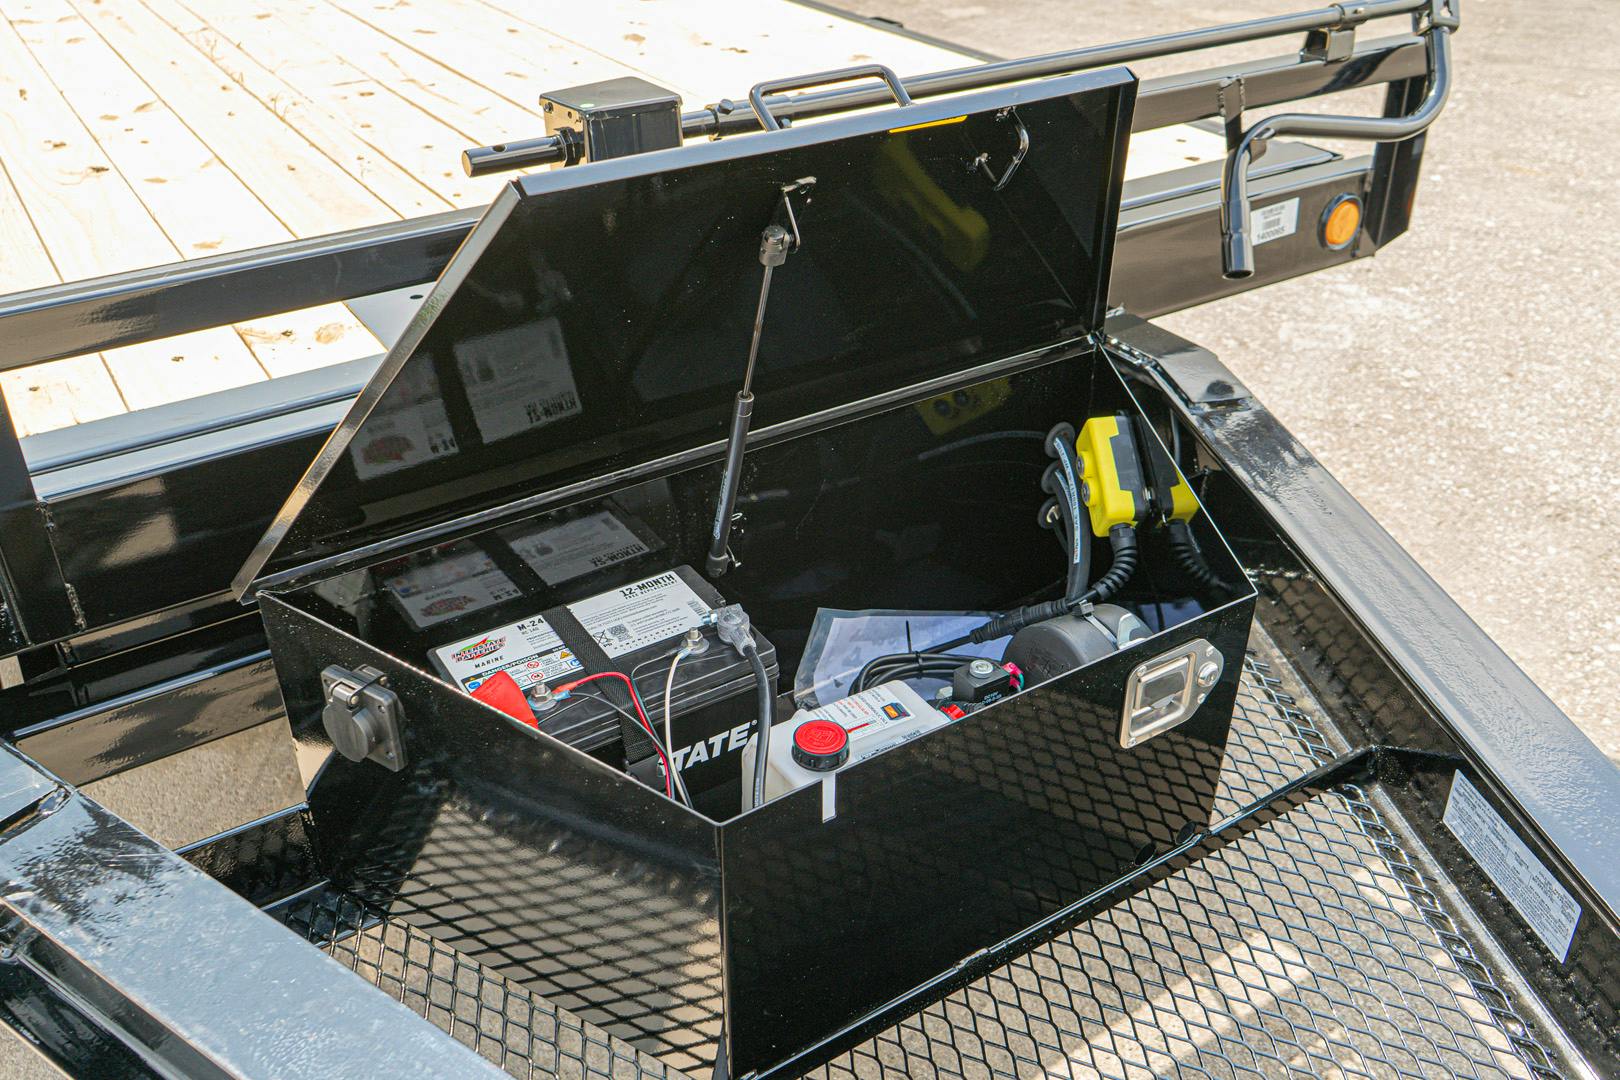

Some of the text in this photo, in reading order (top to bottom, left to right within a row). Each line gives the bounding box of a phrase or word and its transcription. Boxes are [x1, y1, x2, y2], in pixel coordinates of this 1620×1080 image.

[619, 574, 675, 597] 12-MONTH
[640, 580, 678, 595] REPLACEMENT
[517, 617, 545, 632] M-24
[451, 637, 507, 659] INTERSTATE
[455, 642, 506, 662] BATTERIES
[474, 655, 504, 669] MARINE
[482, 654, 539, 677] DANGER/POISON
